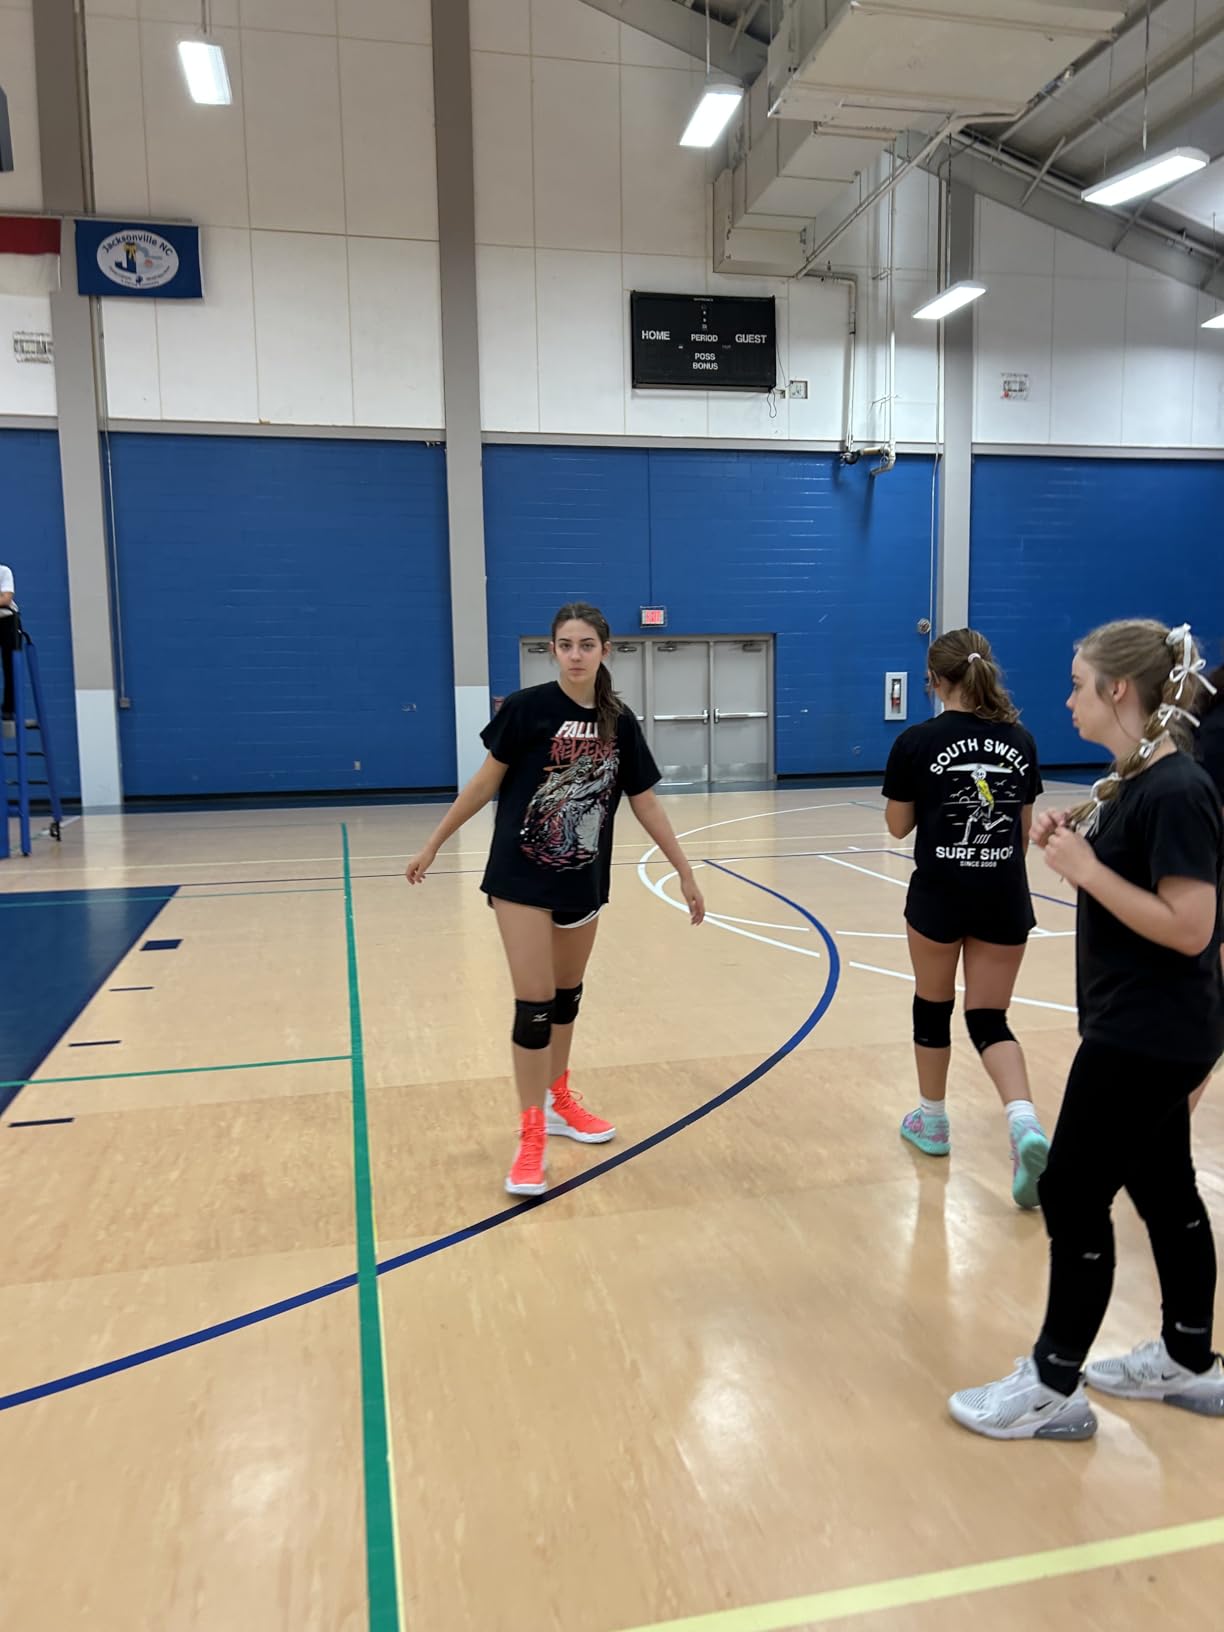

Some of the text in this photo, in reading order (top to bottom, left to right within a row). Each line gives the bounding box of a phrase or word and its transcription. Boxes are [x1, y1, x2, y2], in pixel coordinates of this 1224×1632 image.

[102, 233, 173, 256] Jacksonville NC
[641, 330, 671, 341] HOME
[690, 334, 718, 342] PERIOD
[735, 334, 767, 344] GUEST
[694, 353, 716, 361] POSS
[692, 362, 719, 370] BONUS
[930, 738, 1029, 776] SOUTH SWELL
[935, 846, 976, 859] SURF
[960, 860, 980, 868] SINCE
